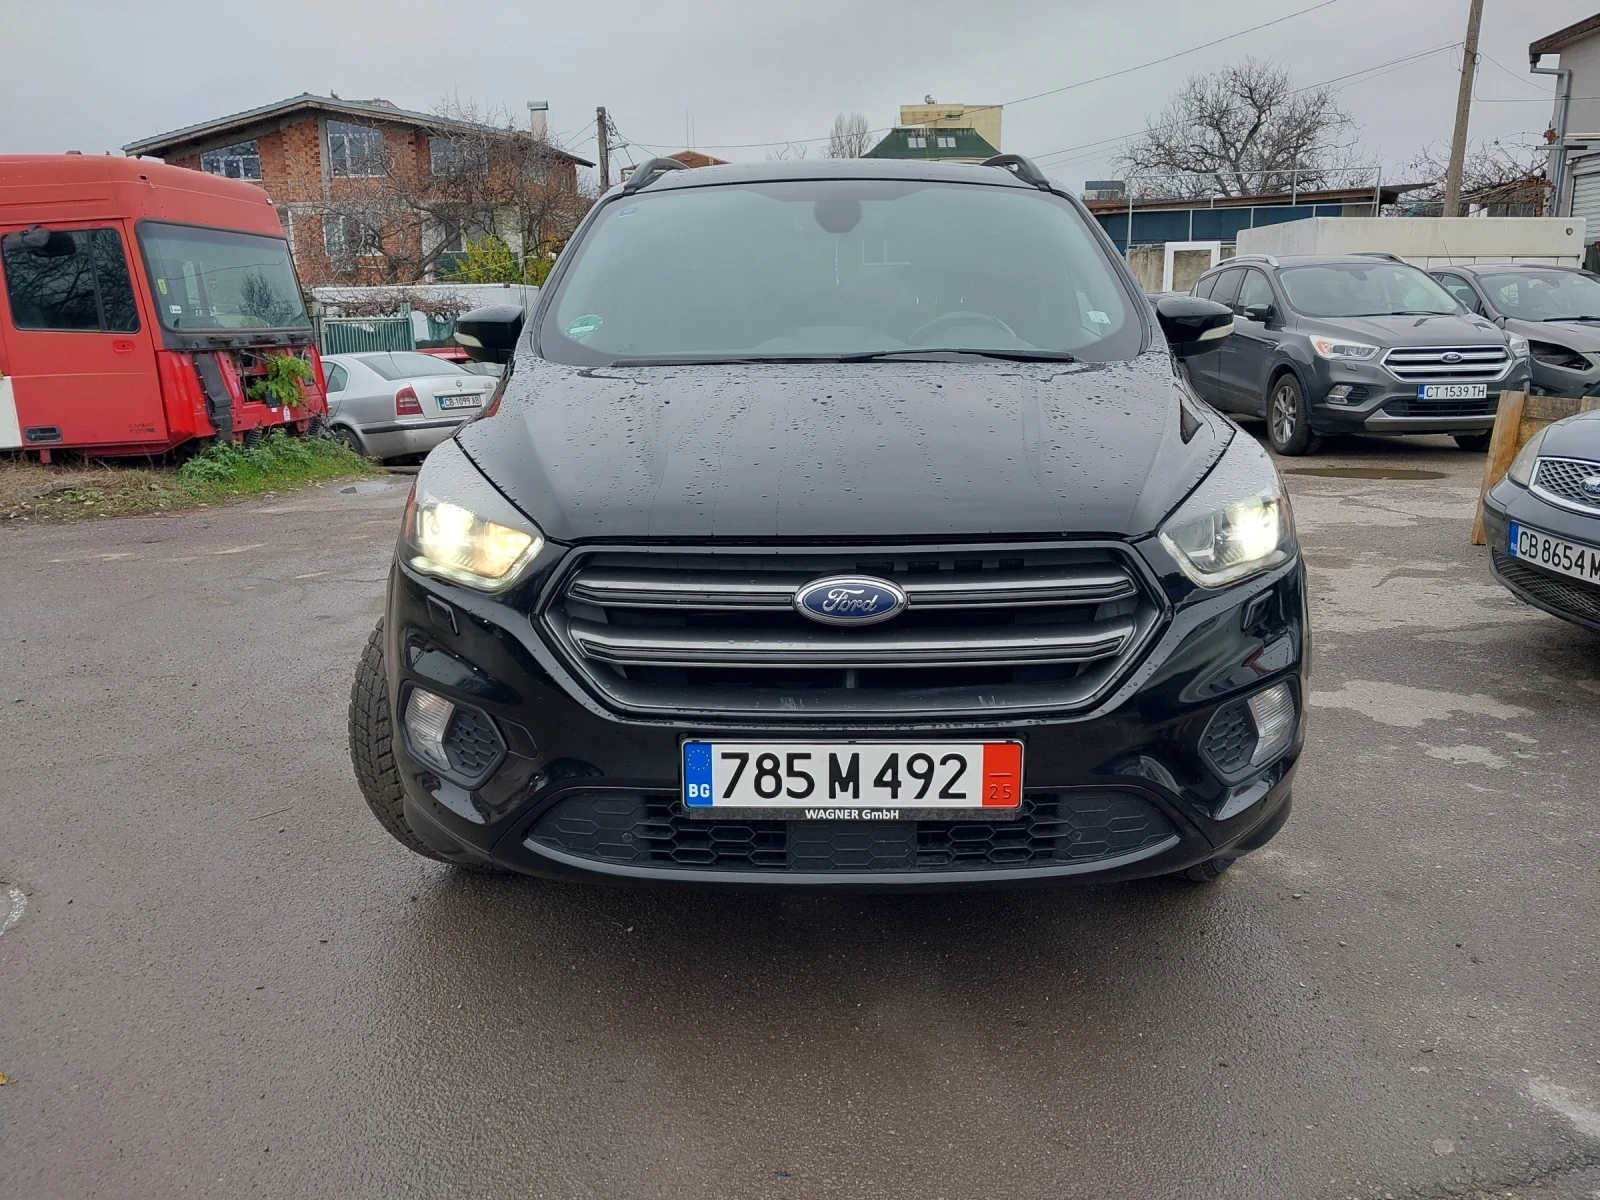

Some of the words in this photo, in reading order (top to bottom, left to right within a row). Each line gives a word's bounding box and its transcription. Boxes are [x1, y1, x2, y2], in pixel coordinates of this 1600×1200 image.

[1426, 386, 1441, 398] CT
[1444, 386, 1470, 398] 1539
[1471, 385, 1485, 397] TH
[1519, 531, 1539, 559] CB
[1541, 538, 1586, 576] 8654
[822, 588, 879, 612] Ford
[720, 752, 815, 799] 785
[828, 752, 860, 799] M
[873, 752, 968, 799] 492
[688, 783, 710, 798] BG
[989, 783, 1012, 800] 25
[805, 808, 859, 820] WAGNER
[861, 808, 900, 820] GmbH
